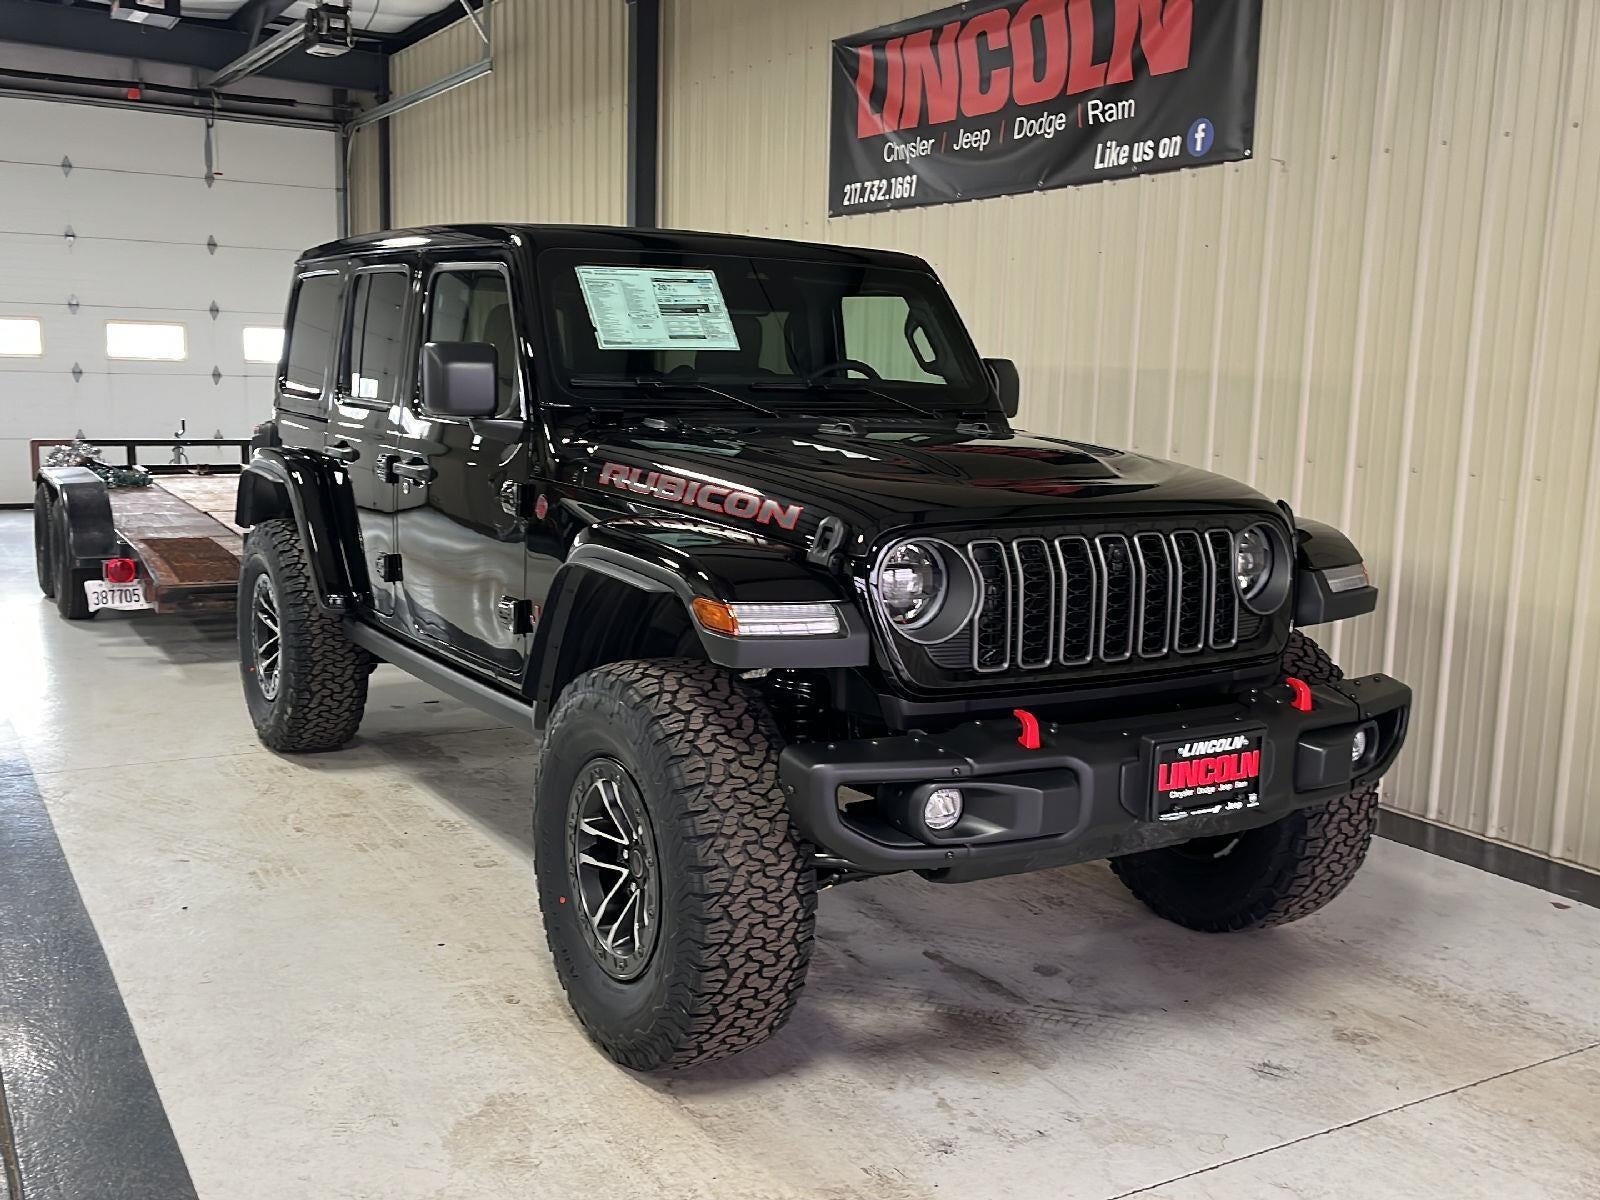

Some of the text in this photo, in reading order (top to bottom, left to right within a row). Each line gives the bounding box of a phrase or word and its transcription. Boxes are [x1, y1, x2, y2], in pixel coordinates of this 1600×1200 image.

[857, 0, 1192, 138] LINCOLN
[883, 98, 1136, 165] Chrysler Jeep Dodge Ram
[1093, 141, 1130, 171] Like
[1132, 138, 1155, 163] us
[1158, 134, 1183, 160] on
[842, 174, 918, 206] 217.732.1661
[598, 461, 804, 531] RUBICON
[92, 589, 140, 605] 387705
[1182, 736, 1244, 757] LINCOLN
[1159, 750, 1259, 791] LINCOLN
